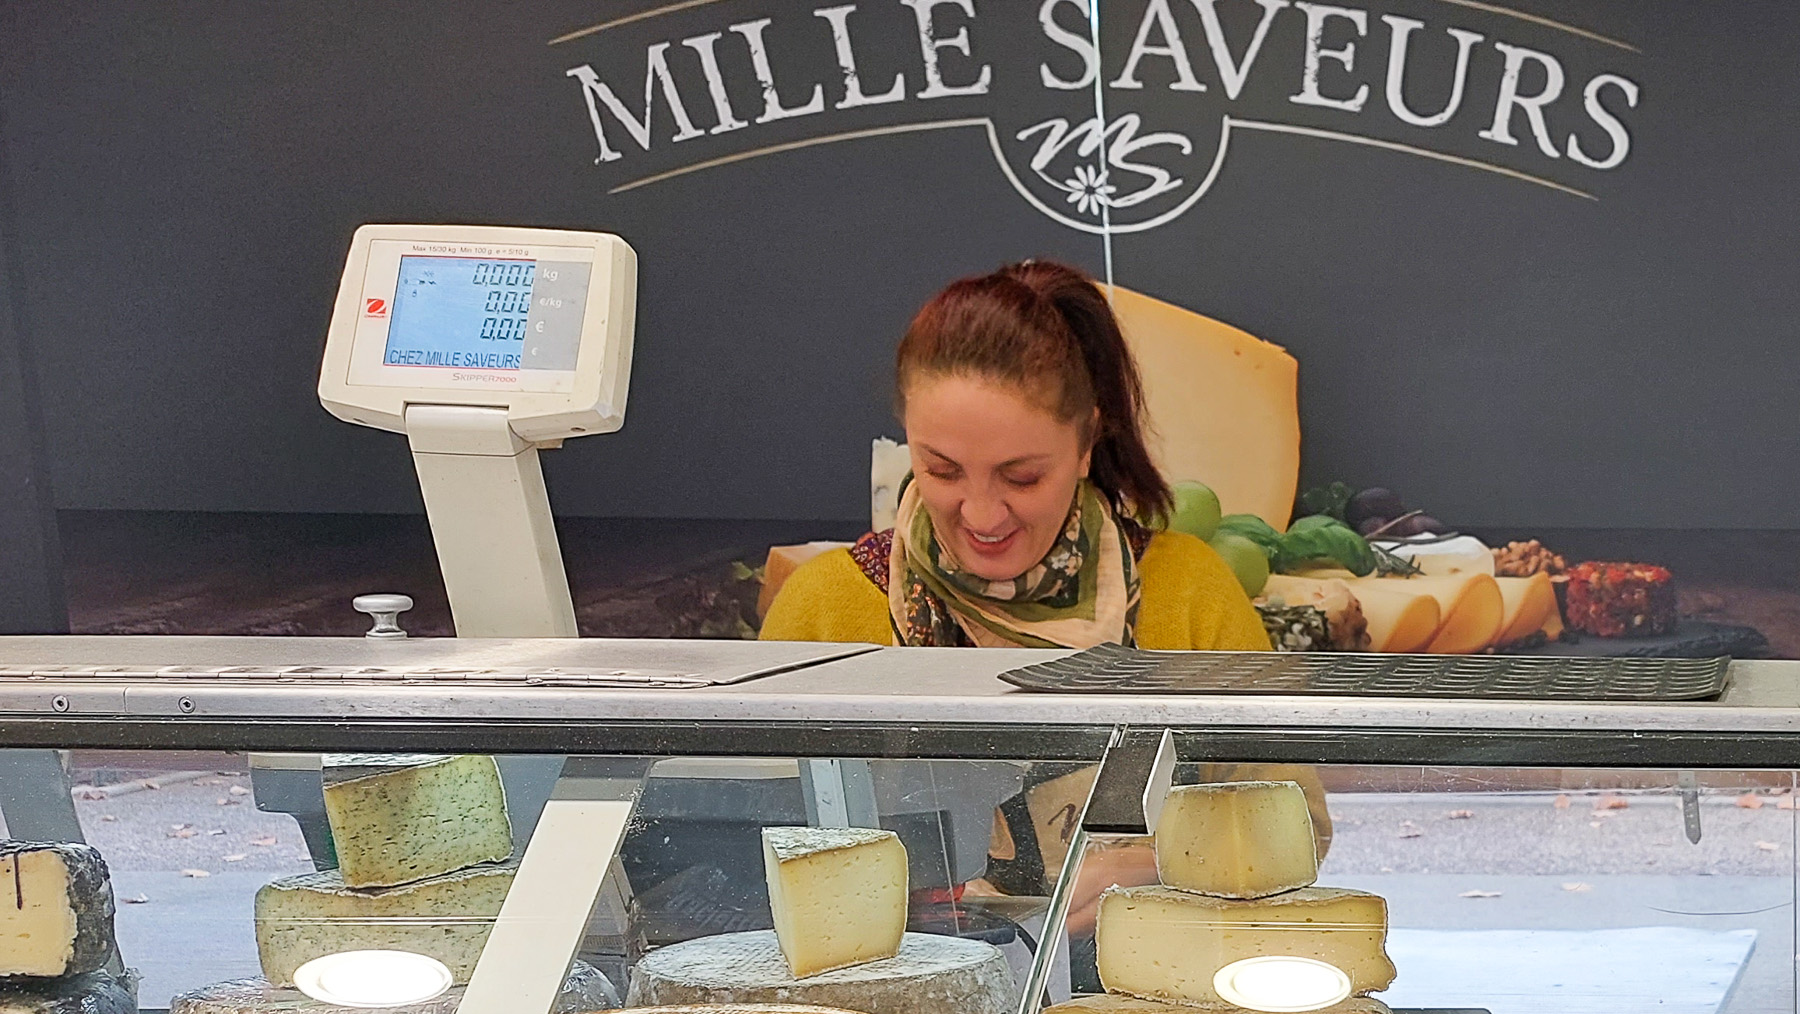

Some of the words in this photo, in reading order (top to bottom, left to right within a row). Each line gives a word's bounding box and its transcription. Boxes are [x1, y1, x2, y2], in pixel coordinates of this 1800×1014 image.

[567, 0, 991, 166] MILLE
[1039, 0, 1644, 169] SAVEURS
[542, 268, 558, 281] kg
[390, 349, 422, 365] CHEZ
[426, 352, 460, 367] MILLE
[463, 353, 520, 369] SAVEURS
